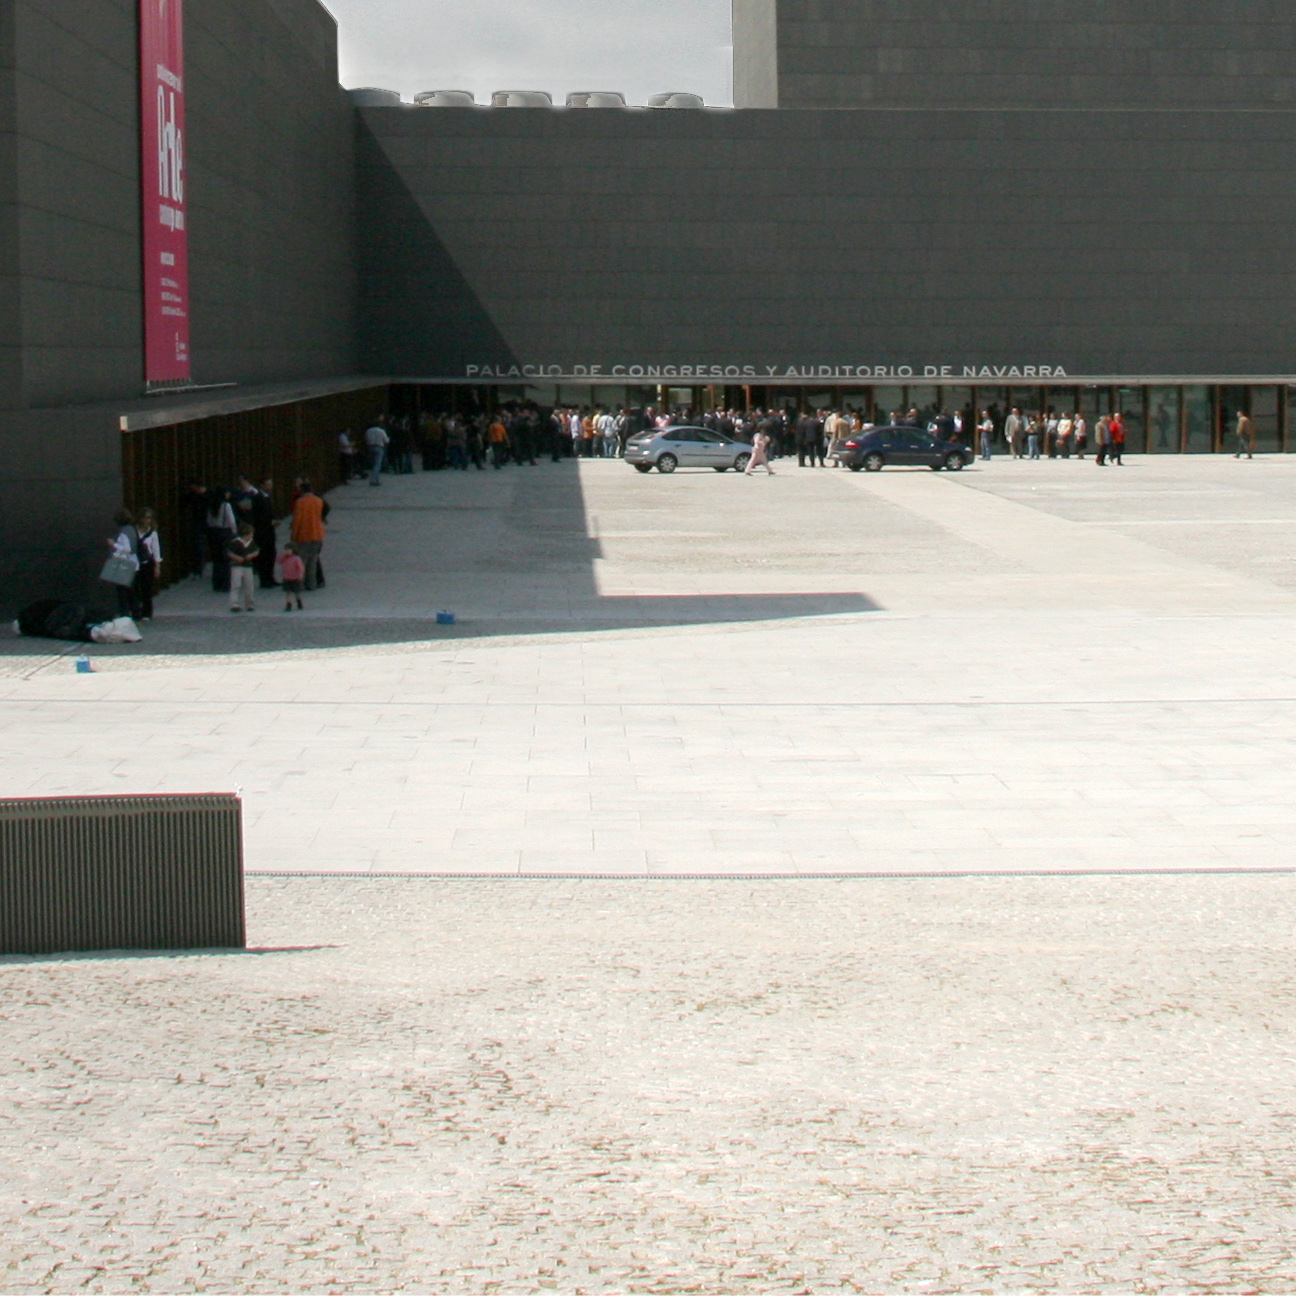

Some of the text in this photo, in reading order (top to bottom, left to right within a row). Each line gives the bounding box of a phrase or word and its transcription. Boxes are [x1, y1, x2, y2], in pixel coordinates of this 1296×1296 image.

[466, 364, 1068, 377] PALACIO DE CONGRESOS Y AUDITORIO DE NAVARRA
